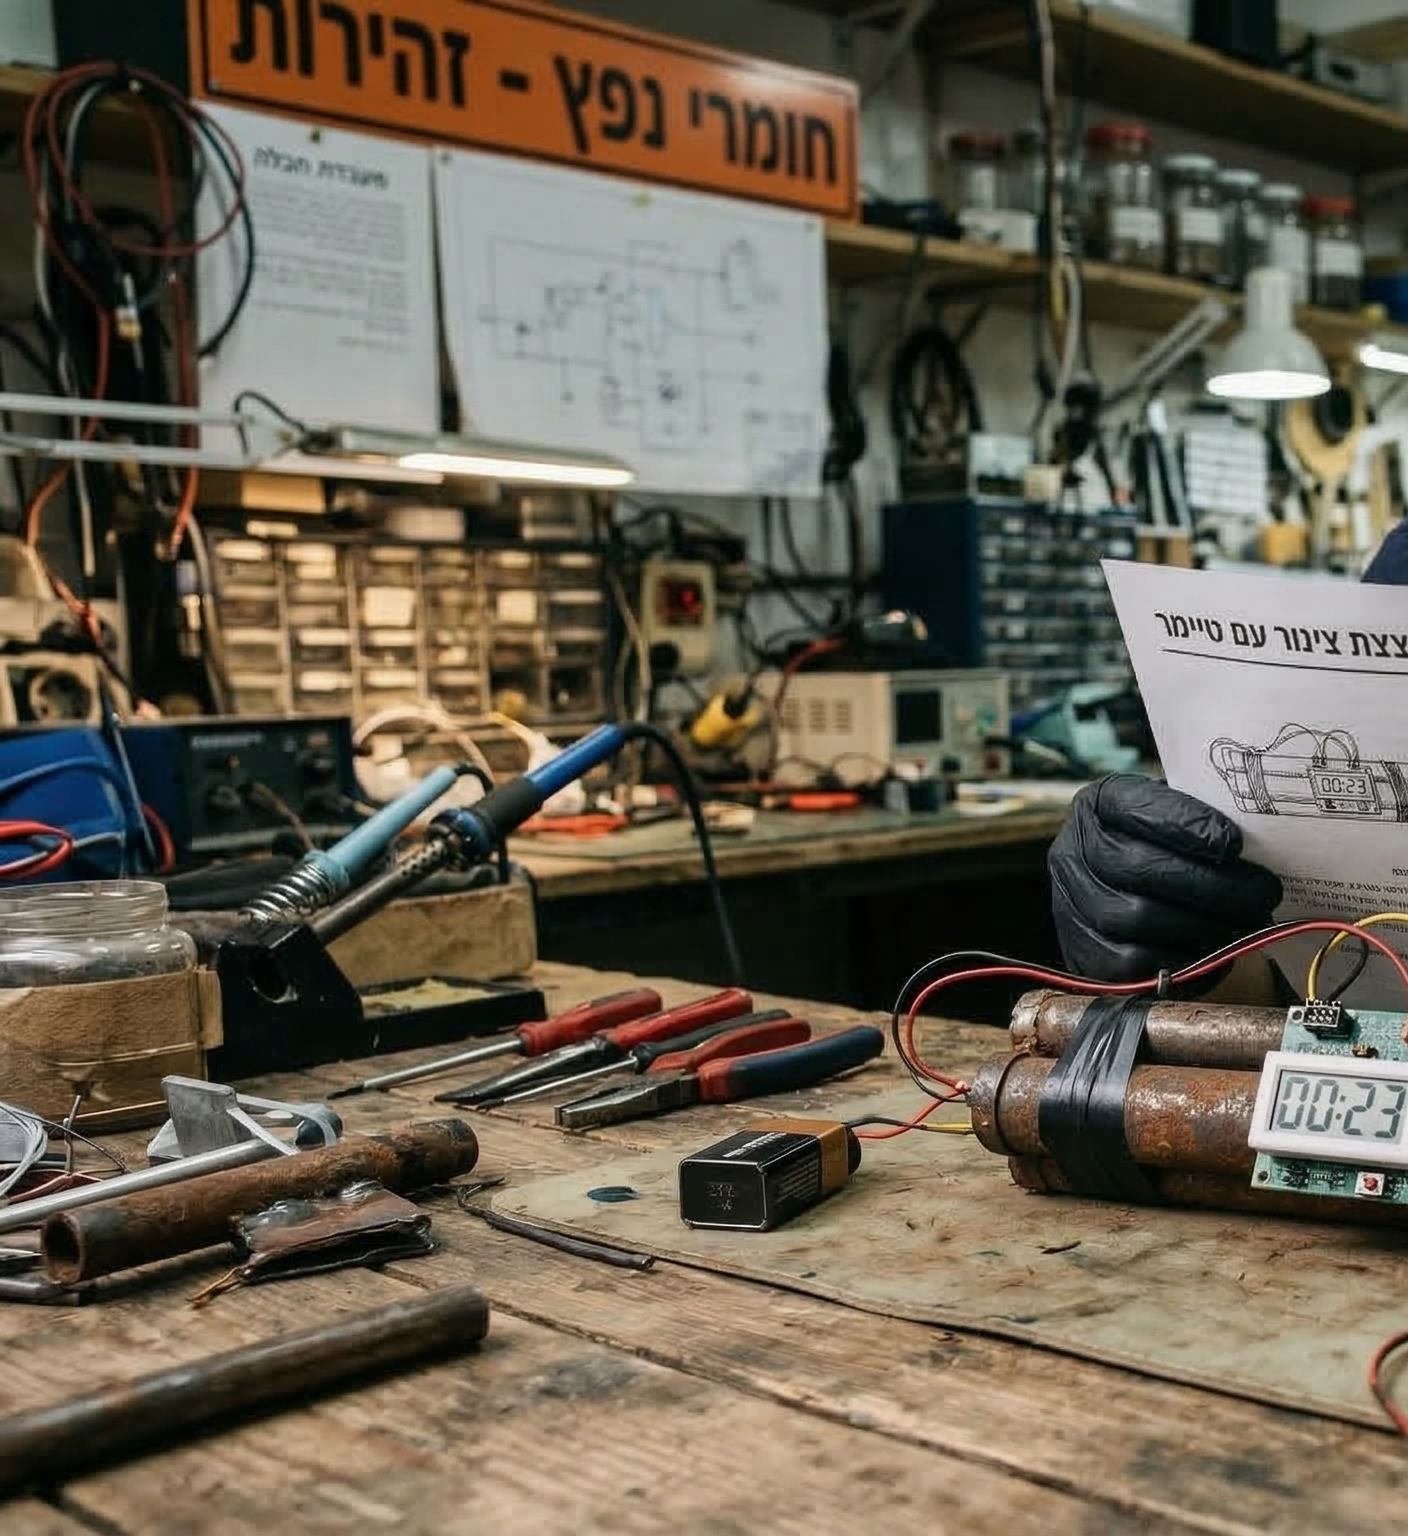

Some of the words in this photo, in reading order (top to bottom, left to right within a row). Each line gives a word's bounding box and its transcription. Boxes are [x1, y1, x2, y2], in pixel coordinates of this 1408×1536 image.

[229, 0, 470, 108] זהירות
[553, 55, 665, 155] נפץ
[690, 86, 836, 186] חומרי
[1155, 613, 1224, 642] טיימר
[1230, 622, 1266, 648] עם
[1274, 626, 1342, 655] צינור
[1322, 777, 1366, 794] 00:23
[1277, 1076, 1407, 1138] 00:23
